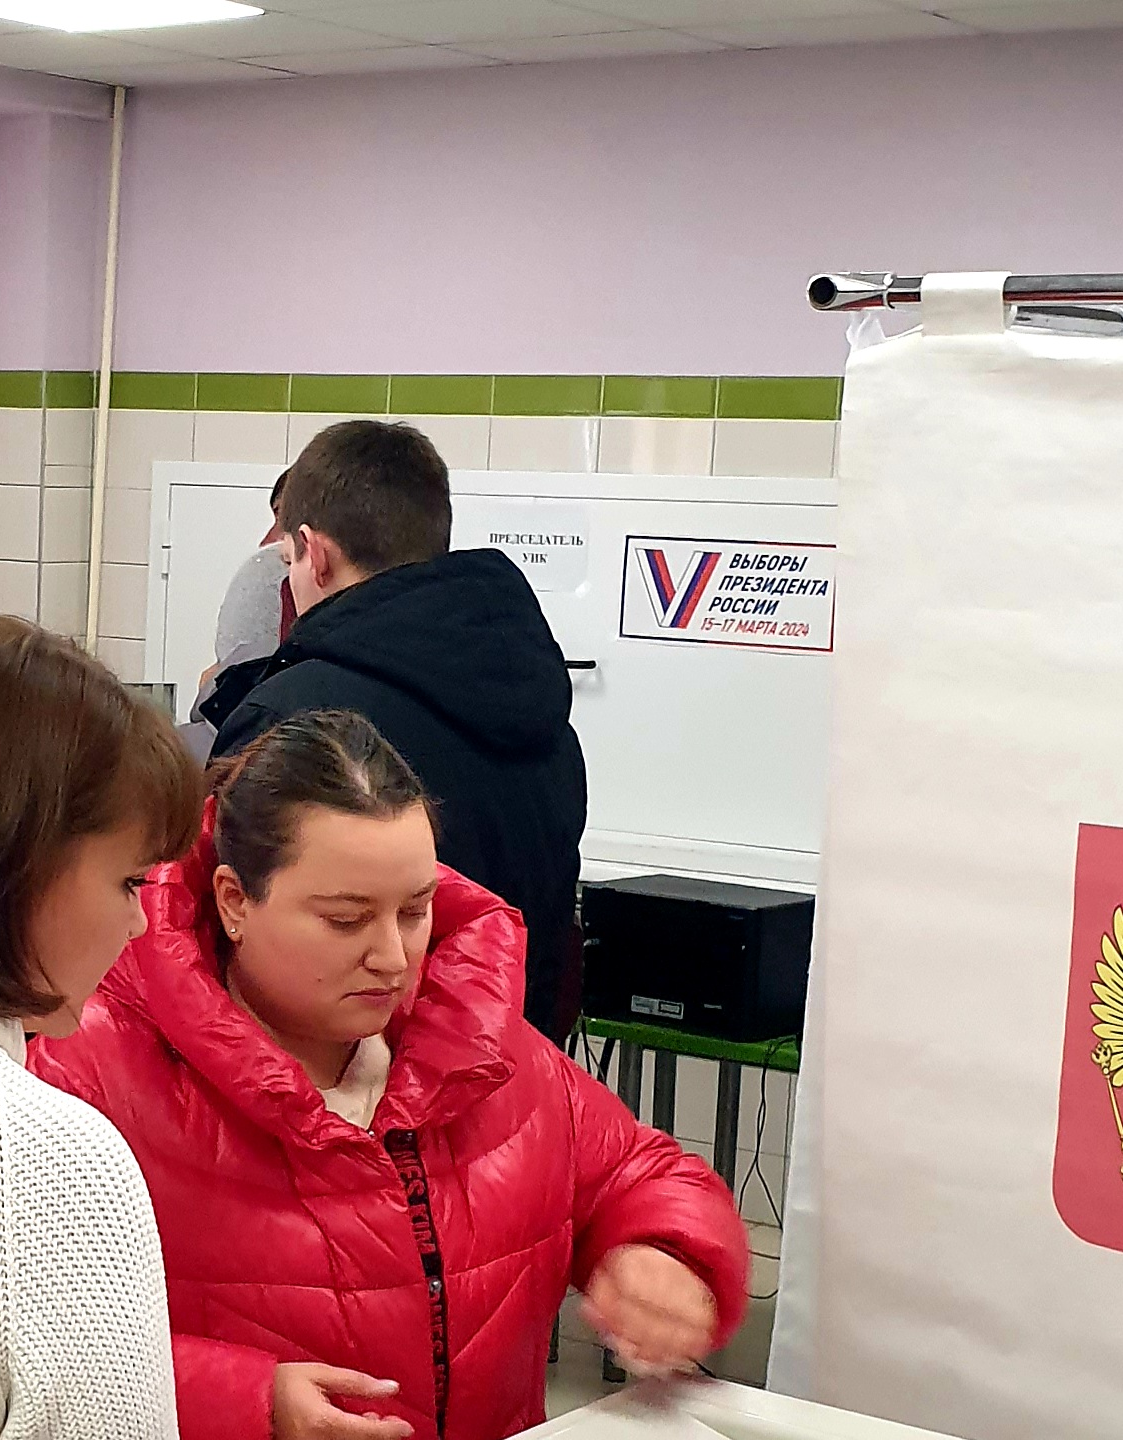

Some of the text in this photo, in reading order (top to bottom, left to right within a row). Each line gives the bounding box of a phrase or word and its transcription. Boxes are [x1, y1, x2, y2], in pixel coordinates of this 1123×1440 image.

[489, 533, 584, 546] ПРЕДСЕДАТЕЛЬ
[522, 552, 548, 563] УИК
[728, 553, 808, 573] ВЫБОРЫ
[718, 575, 829, 597] ПРЕЗИДЕНТА
[708, 596, 780, 616] РОССИИ
[735, 619, 777, 635] МАРТА
[778, 622, 810, 637] 2024
